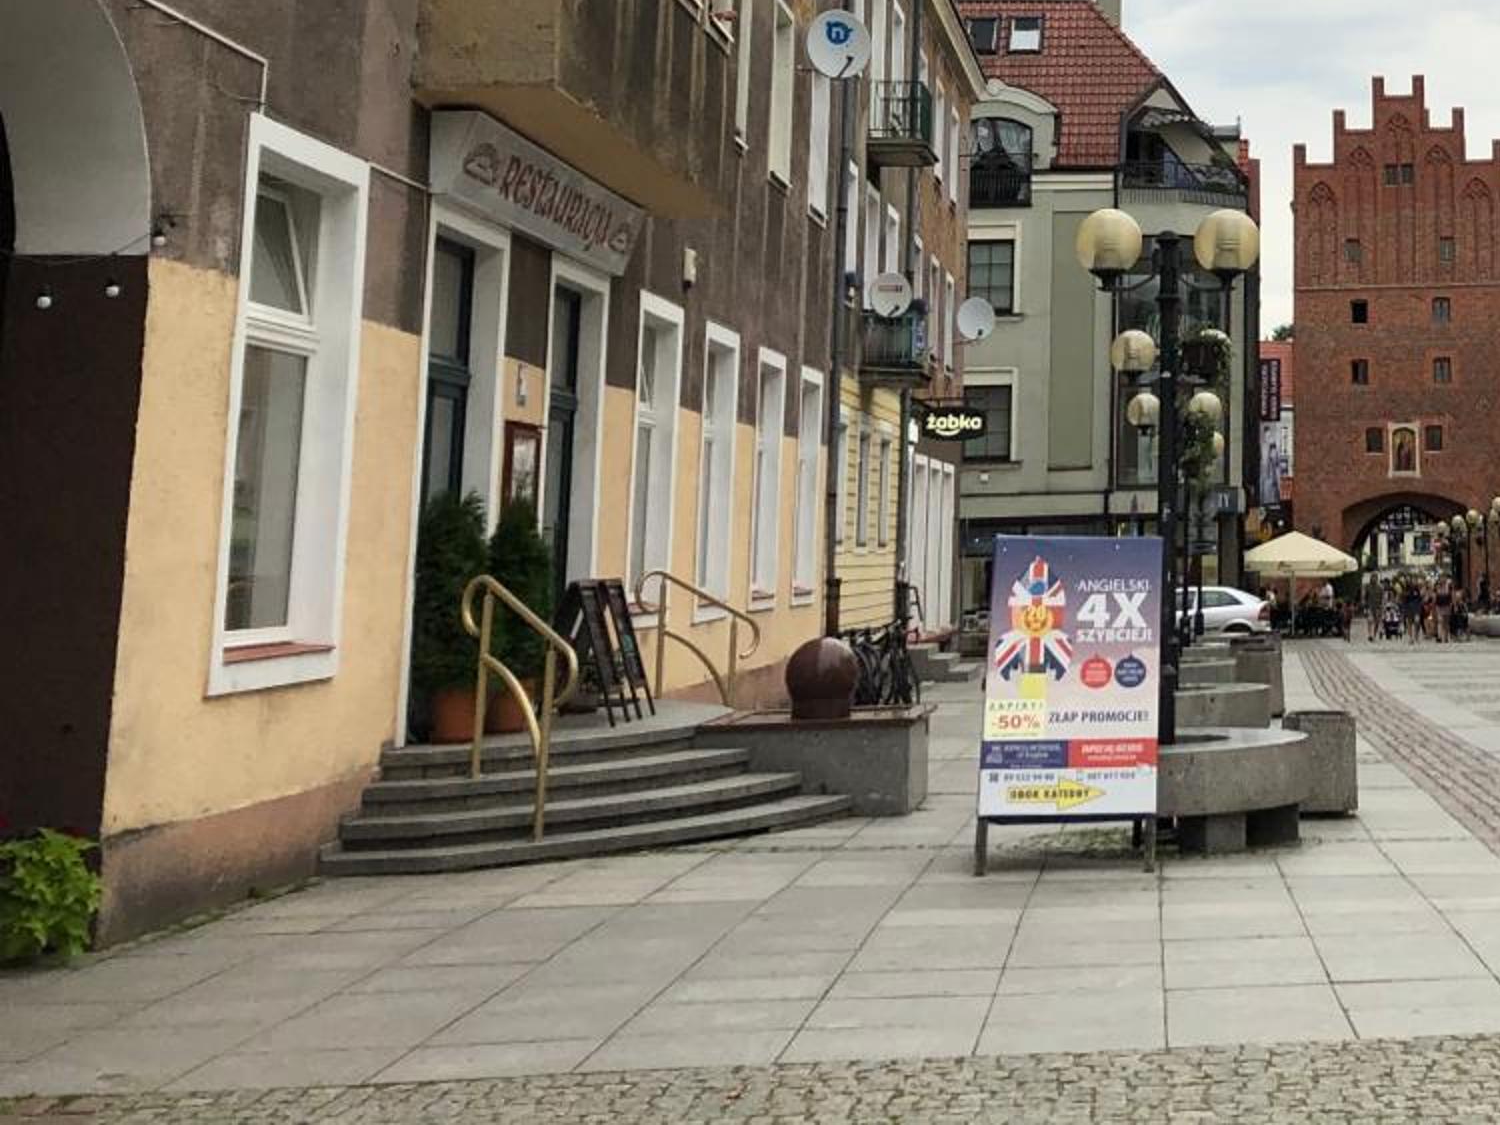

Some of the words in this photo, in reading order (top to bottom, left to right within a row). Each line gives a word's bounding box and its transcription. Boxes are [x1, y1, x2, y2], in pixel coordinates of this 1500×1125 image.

[926, 413, 982, 430] żabka
[1077, 578, 1149, 593] ANGIELSKI
[1076, 592, 1148, 629] 4X
